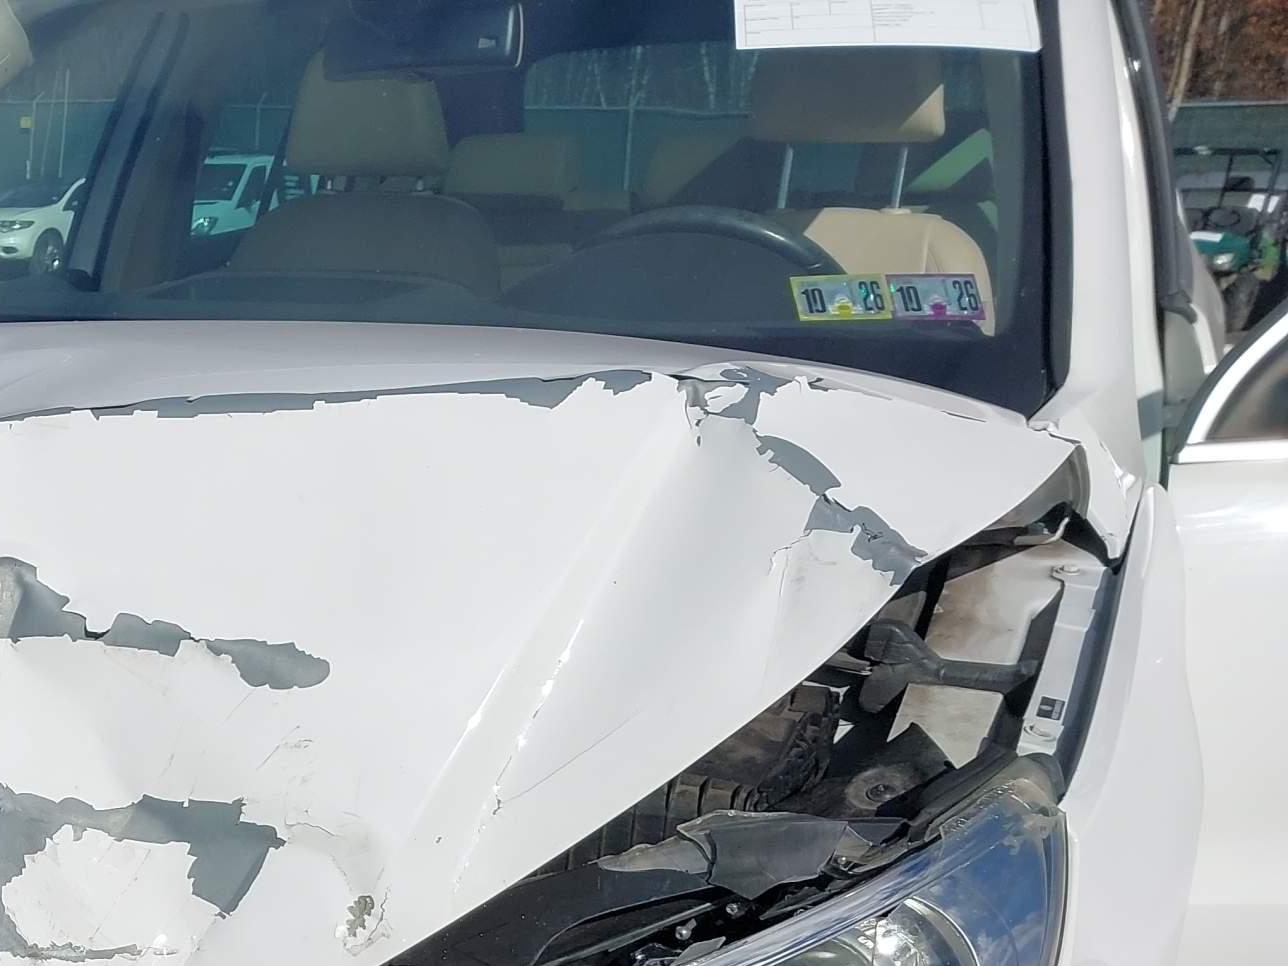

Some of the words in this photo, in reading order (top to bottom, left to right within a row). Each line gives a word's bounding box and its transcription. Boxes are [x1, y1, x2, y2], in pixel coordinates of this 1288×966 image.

[801, 287, 827, 314] 10
[858, 280, 886, 312] 26
[896, 285, 923, 312] 10
[952, 279, 979, 312] 26
